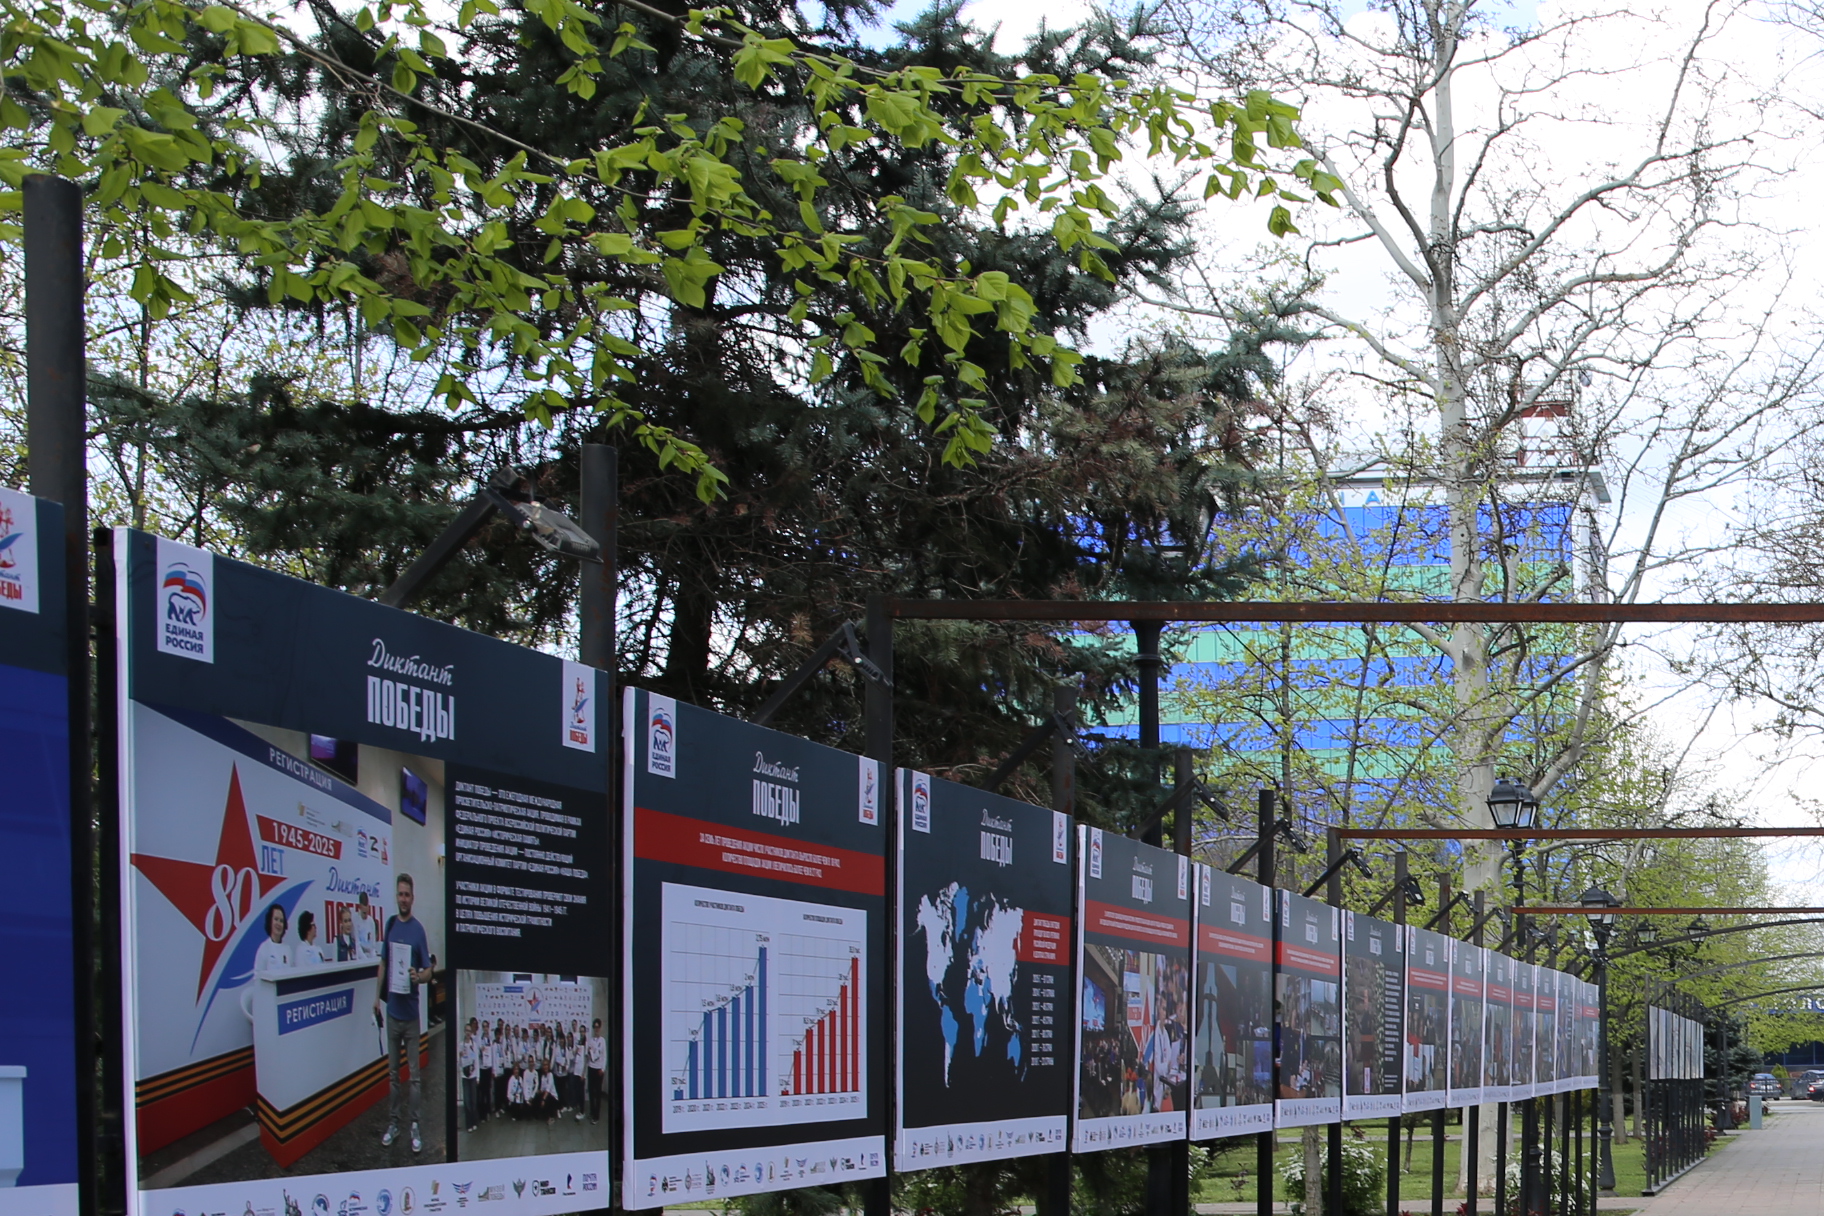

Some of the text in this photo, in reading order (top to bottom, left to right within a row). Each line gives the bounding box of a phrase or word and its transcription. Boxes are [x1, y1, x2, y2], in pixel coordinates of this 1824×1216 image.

[165, 623, 204, 641] ЕДИНАЯ
[165, 635, 204, 654] РОССИЯ
[367, 638, 454, 686] Диктант
[367, 675, 455, 743] ПОБЕДЫ
[269, 748, 332, 791] РЕГИСТРАЦИЯ
[753, 751, 799, 783] Диктант
[753, 779, 800, 826] ПОБЕДЫ
[272, 822, 335, 856] 1945-2025
[261, 845, 285, 875] ЛЕТ
[326, 866, 380, 898] Диктант
[205, 864, 261, 941] 80
[286, 996, 347, 1024] РЕГИСТРАЦИЯ
